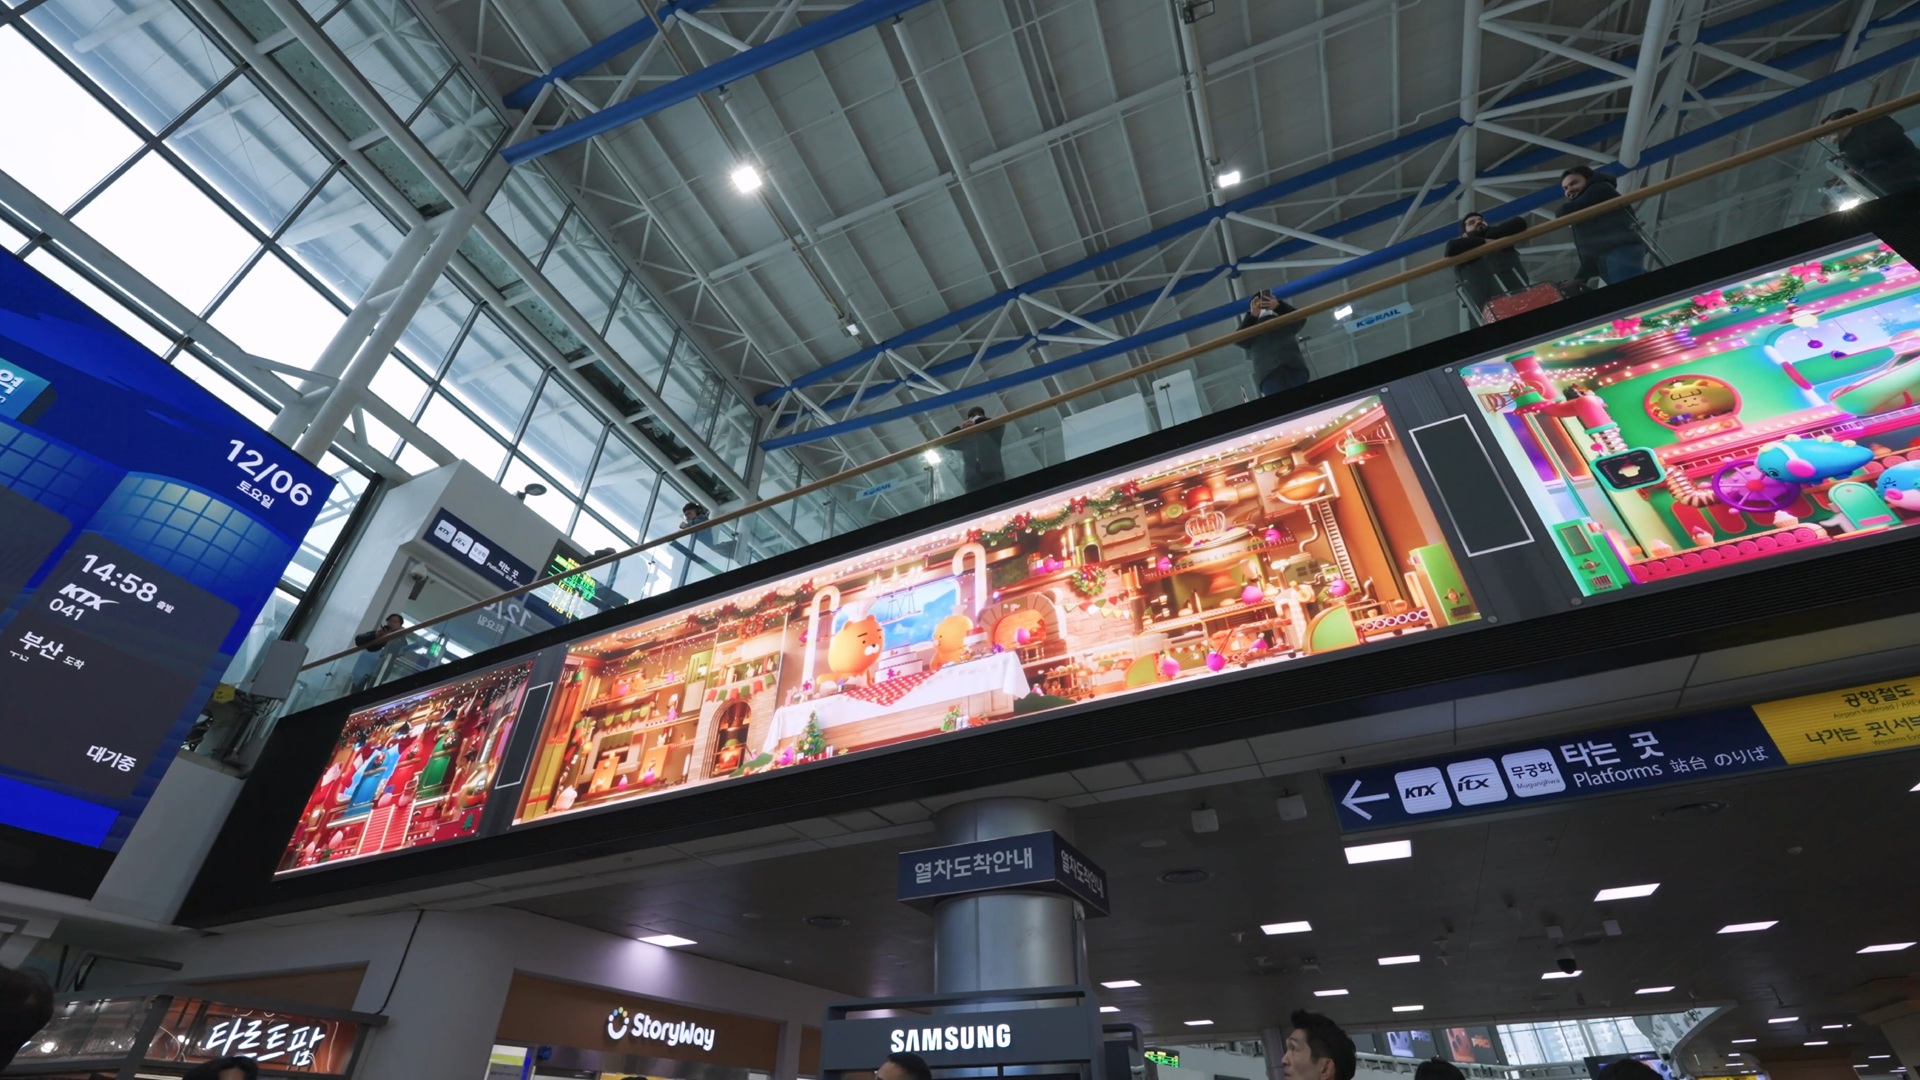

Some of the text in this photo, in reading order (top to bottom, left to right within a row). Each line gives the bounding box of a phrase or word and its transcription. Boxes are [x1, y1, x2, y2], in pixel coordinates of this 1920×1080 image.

[1356, 309, 1402, 328] KORAIL
[227, 439, 313, 506] 12/06
[236, 480, 275, 509] 토요일
[82, 554, 158, 602] 14:58
[49, 598, 85, 621] 041
[58, 582, 120, 611] KTX
[19, 631, 64, 660] 부산
[62, 655, 85, 670] 도착
[1841, 684, 1915, 708] 공항철도
[1833, 709, 1861, 719] Airport
[1861, 703, 1895, 714] Railroad
[1560, 731, 1664, 767] 타는 곳
[1805, 727, 1862, 745] 나가는
[86, 745, 137, 772] 대기중
[1511, 761, 1554, 779] 무궁화
[1573, 746, 1769, 788] Platforms 站台 のりば
[1405, 781, 1440, 799] KTX
[1516, 778, 1561, 791] Mugunghwa
[915, 847, 1033, 884] 열차도착안내
[891, 1024, 1011, 1053] SAMSUNG
